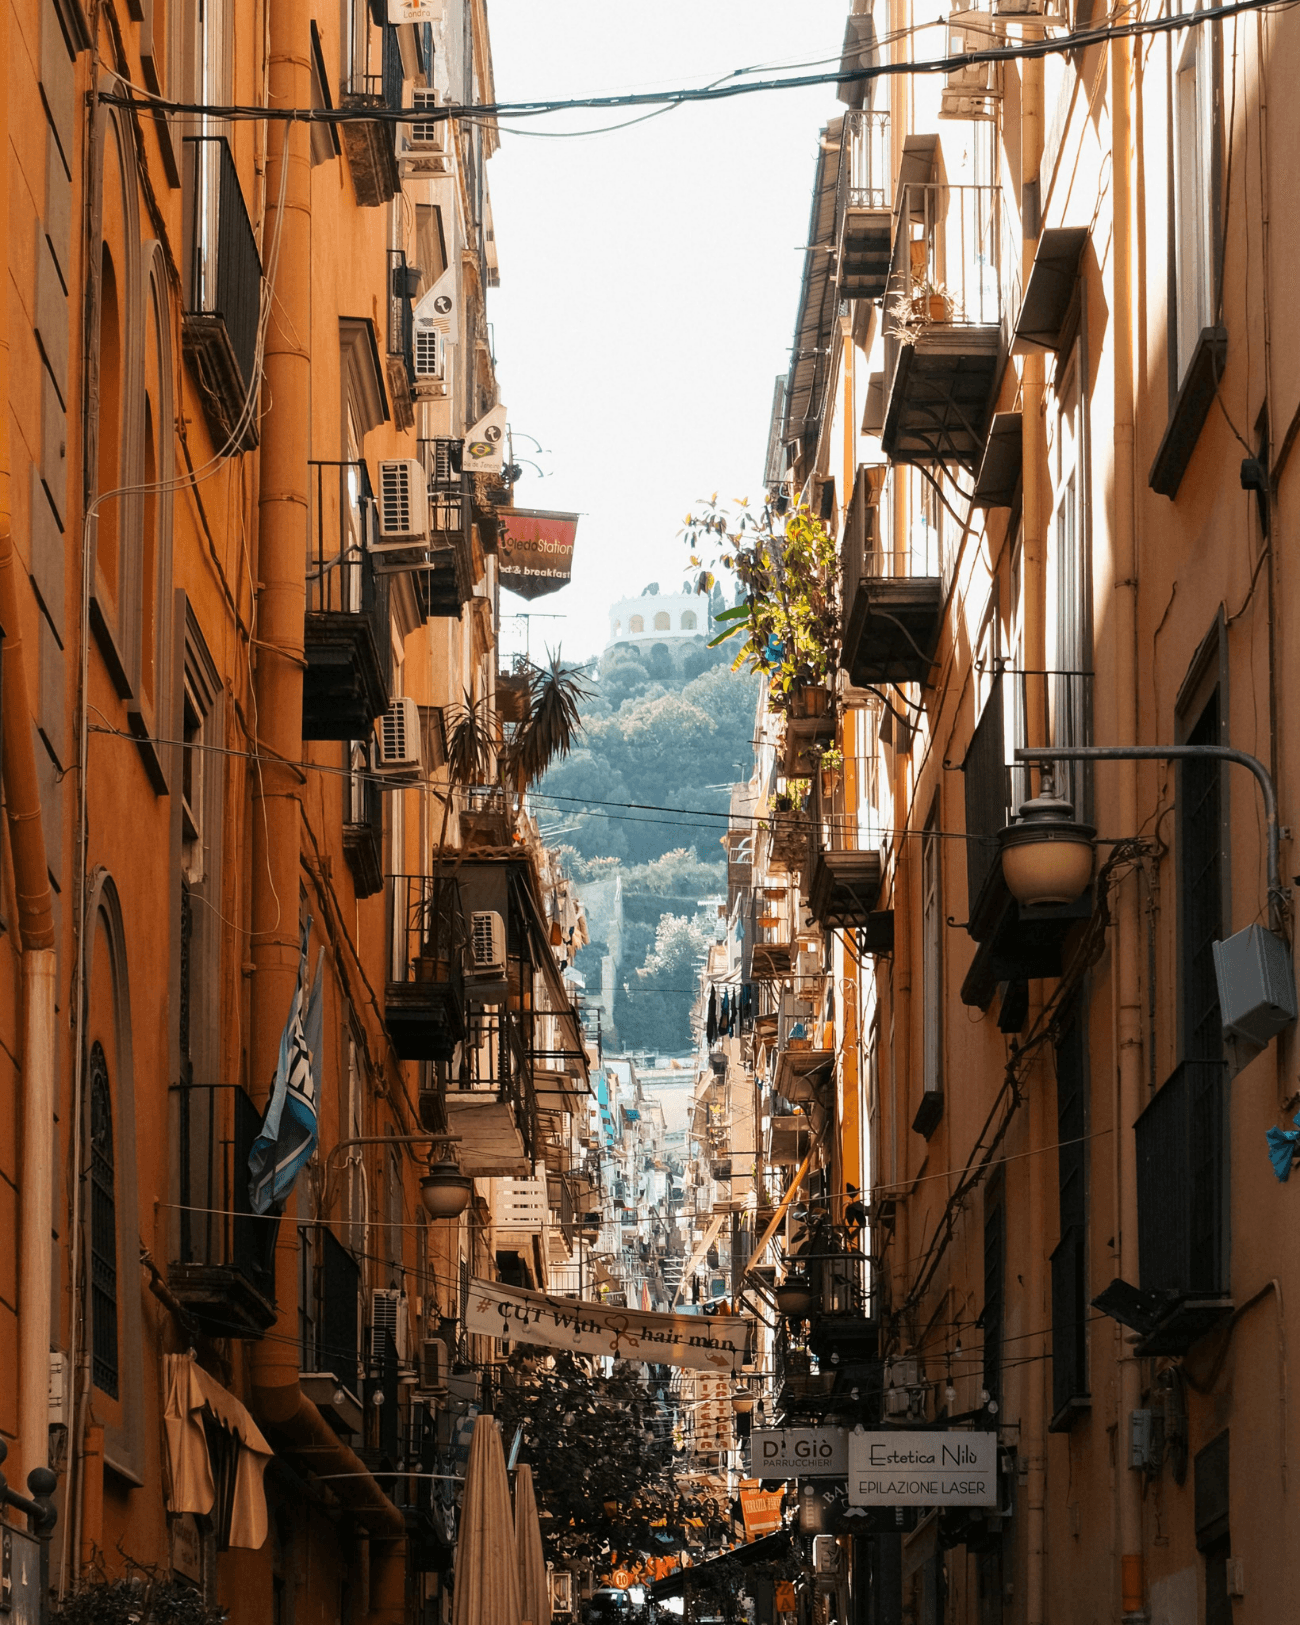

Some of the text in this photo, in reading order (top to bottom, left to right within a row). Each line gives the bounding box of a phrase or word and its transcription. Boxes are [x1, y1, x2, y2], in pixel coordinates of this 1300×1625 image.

[403, 9, 431, 19] Londra
[523, 566, 571, 579] breakfast
[498, 1302, 545, 1324] CUT
[640, 1326, 683, 1345] hair
[689, 1336, 734, 1351] man
[794, 1439, 833, 1458] Giò
[868, 1444, 977, 1466] Estetica Nilù
[763, 1459, 832, 1467] PARRUCCHIERI
[859, 1481, 985, 1494] EPILAZIONE LASER
